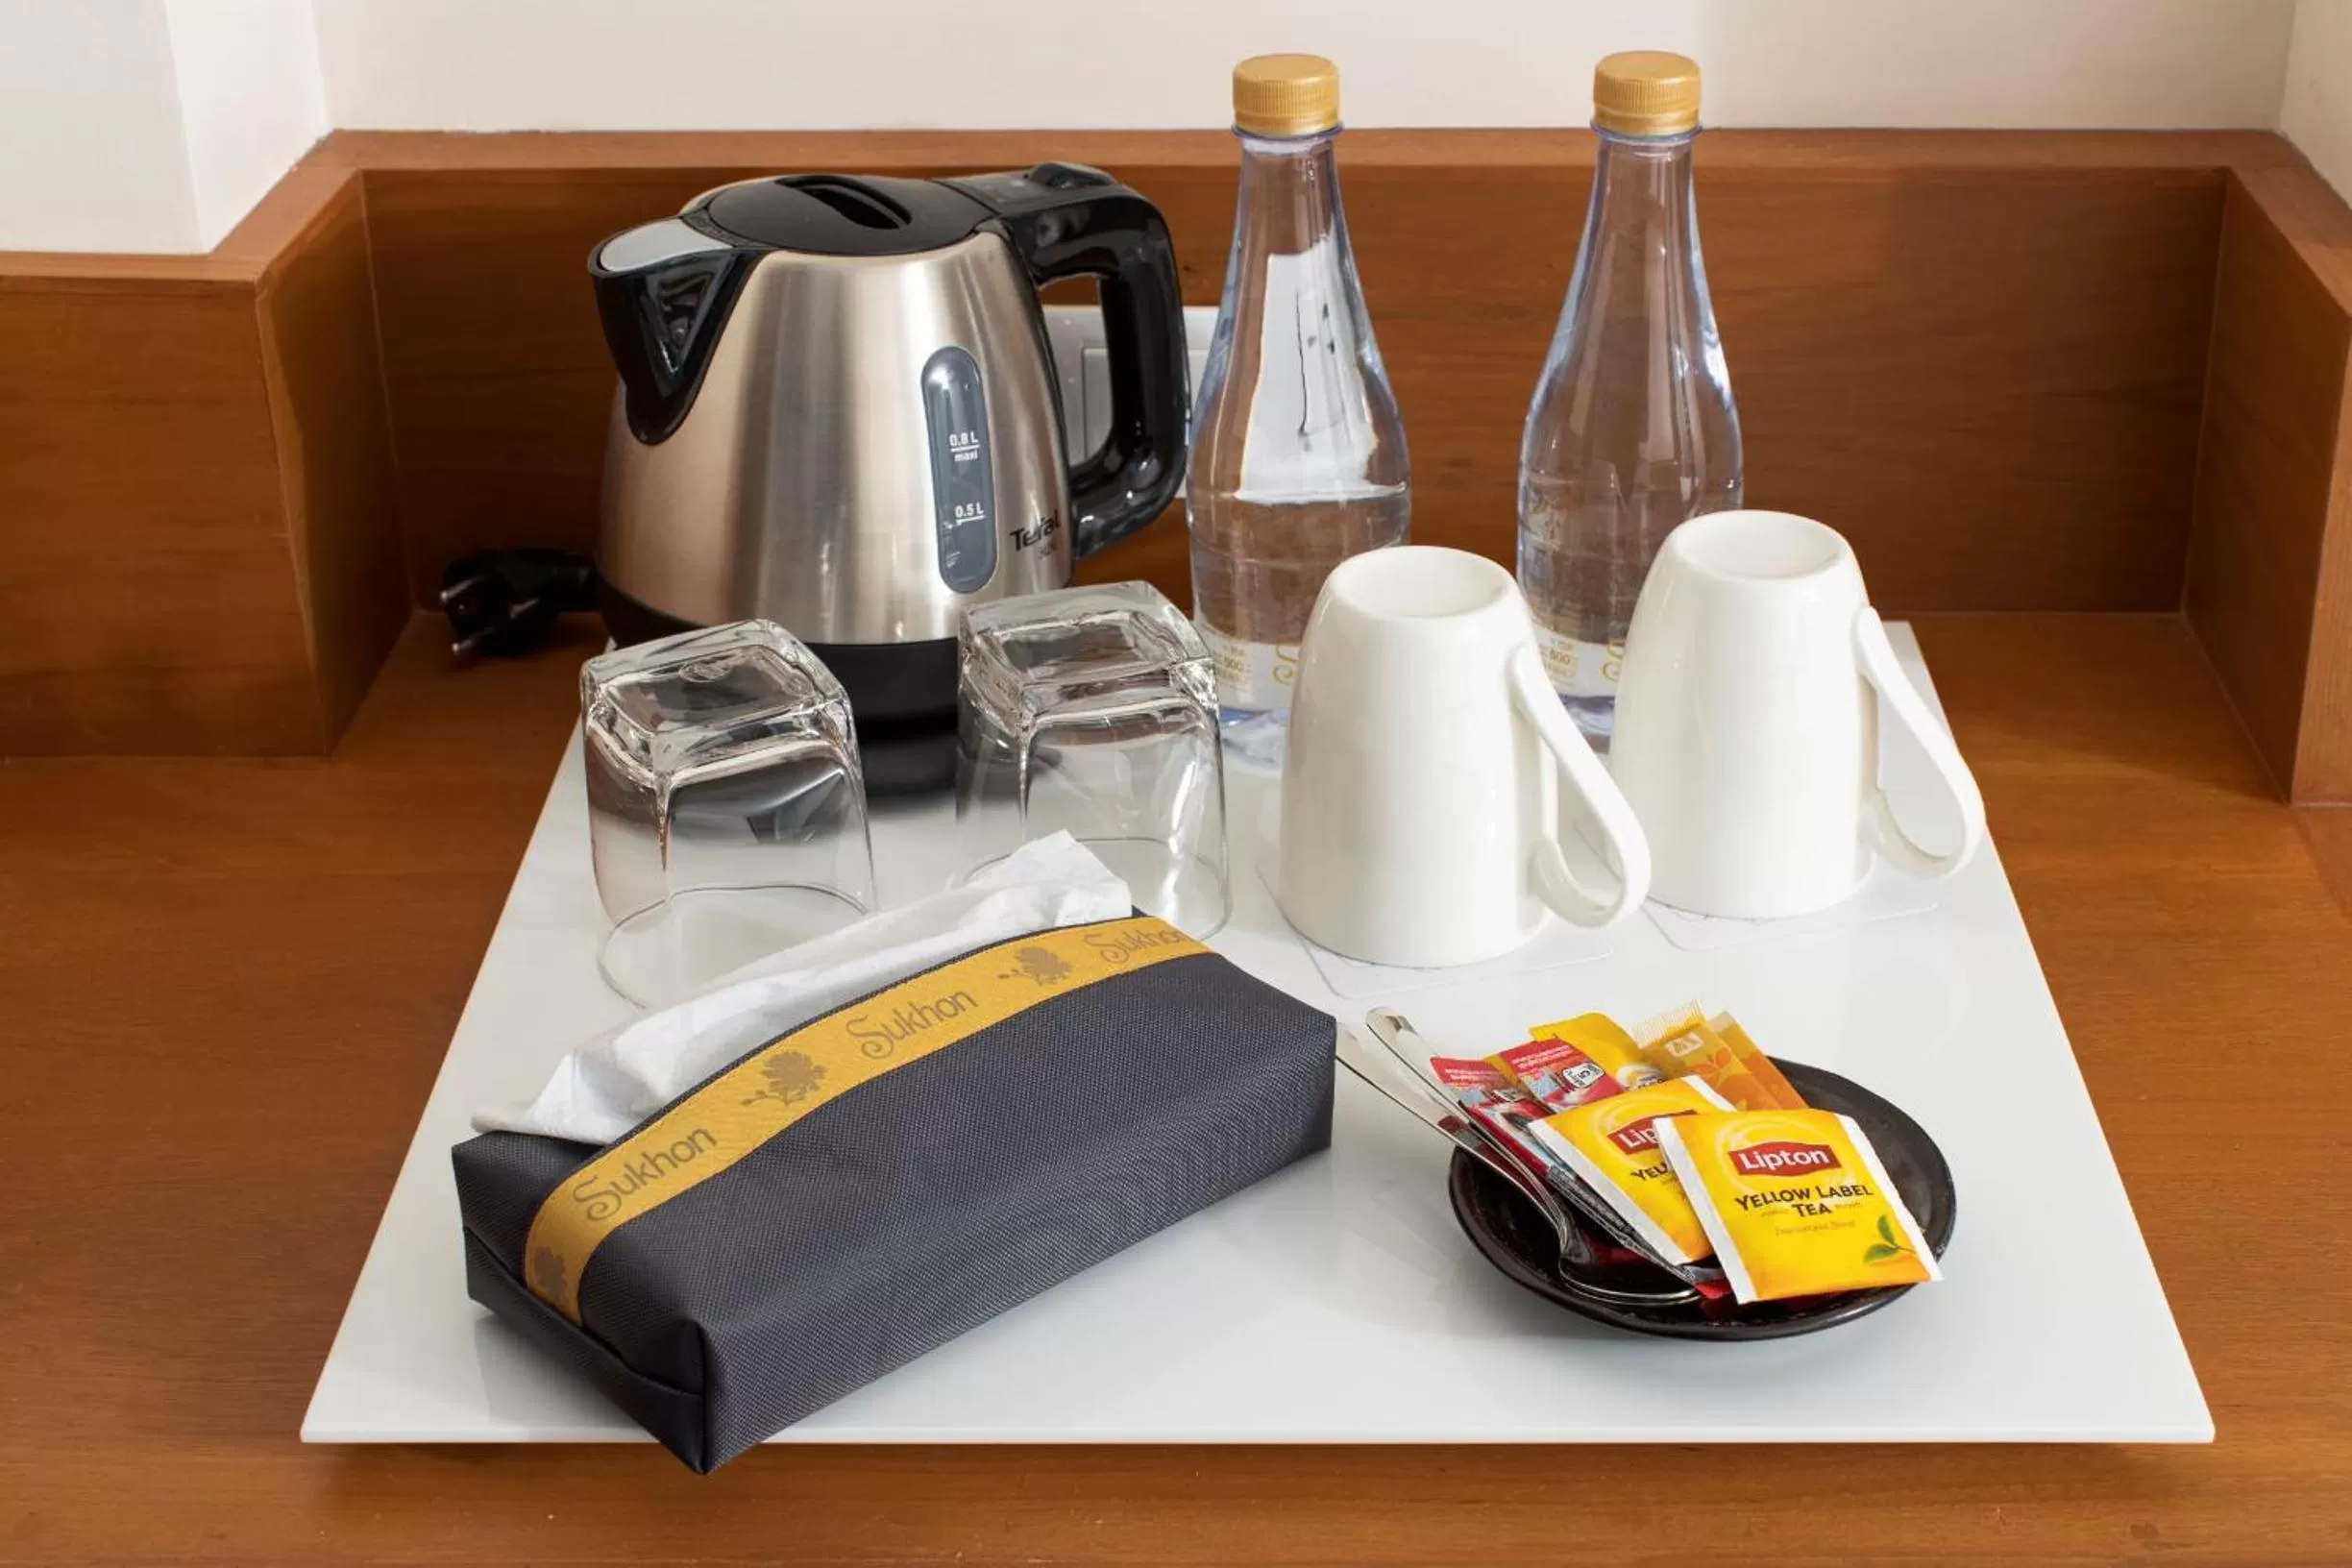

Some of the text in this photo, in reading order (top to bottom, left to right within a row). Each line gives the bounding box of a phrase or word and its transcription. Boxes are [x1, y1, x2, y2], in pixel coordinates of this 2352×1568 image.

[949, 430, 978, 446] 0.8 L
[955, 502, 984, 518] 0.5 L
[845, 990, 979, 1060] Sukhon
[1738, 1149, 1830, 1170] Lipton
[573, 1128, 718, 1222] Sukhon
[1734, 1185, 1874, 1212] YELLOW LABEL
[1791, 1202, 1833, 1217] TEA
